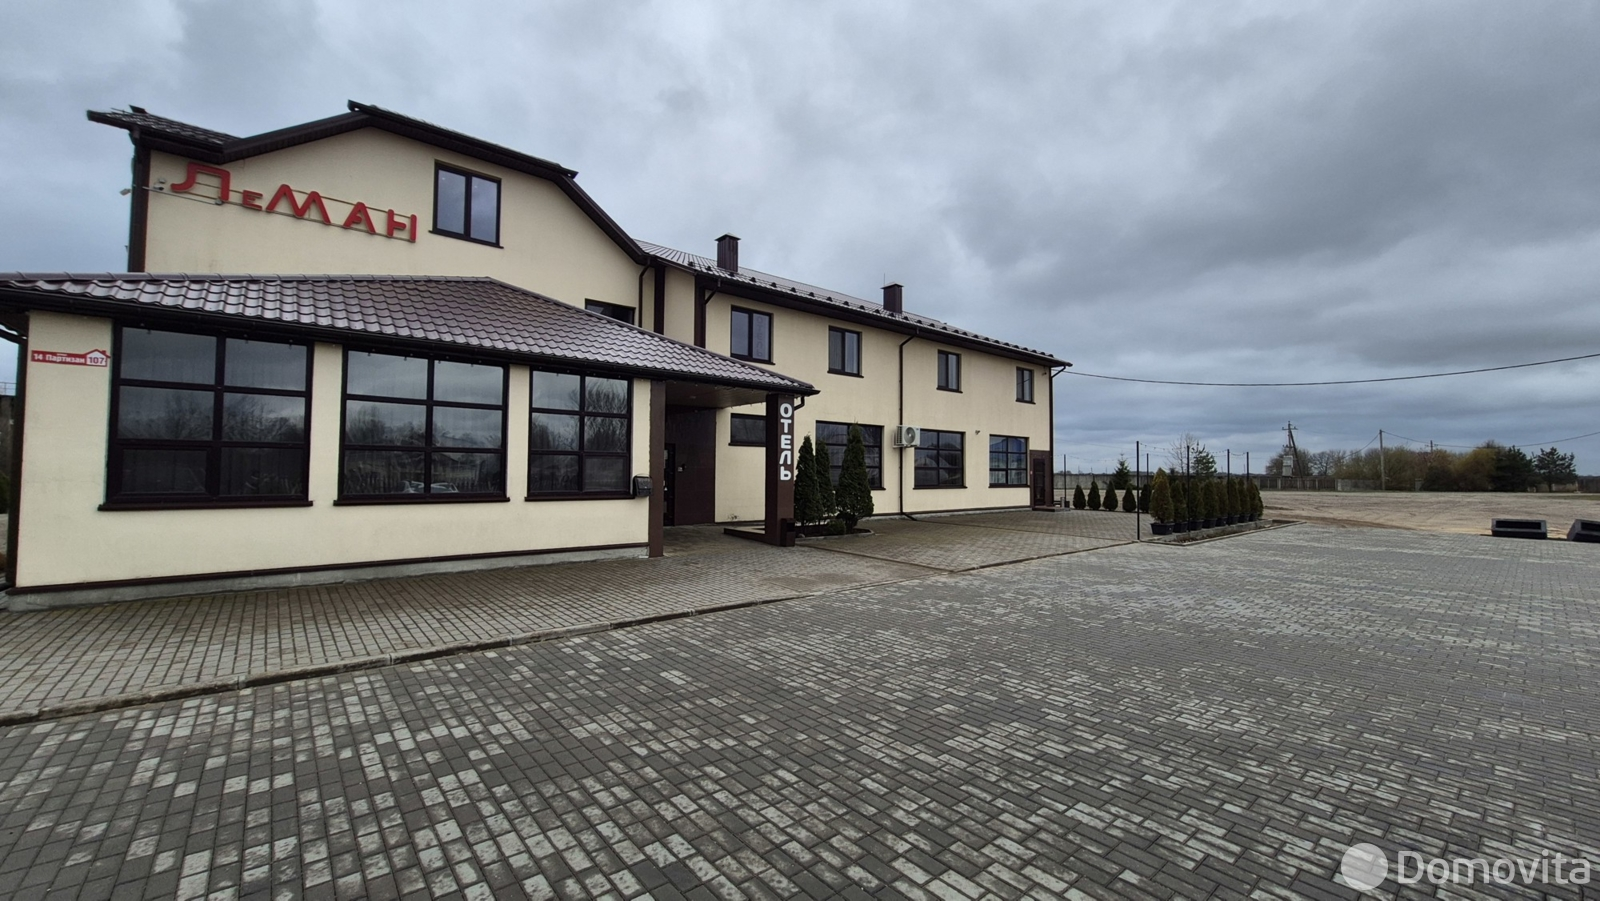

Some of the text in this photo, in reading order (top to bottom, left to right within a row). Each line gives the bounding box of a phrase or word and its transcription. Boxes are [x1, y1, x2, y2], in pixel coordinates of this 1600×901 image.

[34, 353, 43, 361] 14
[45, 354, 85, 364] Партизан
[779, 403, 793, 481] ОТЕЛЬ
